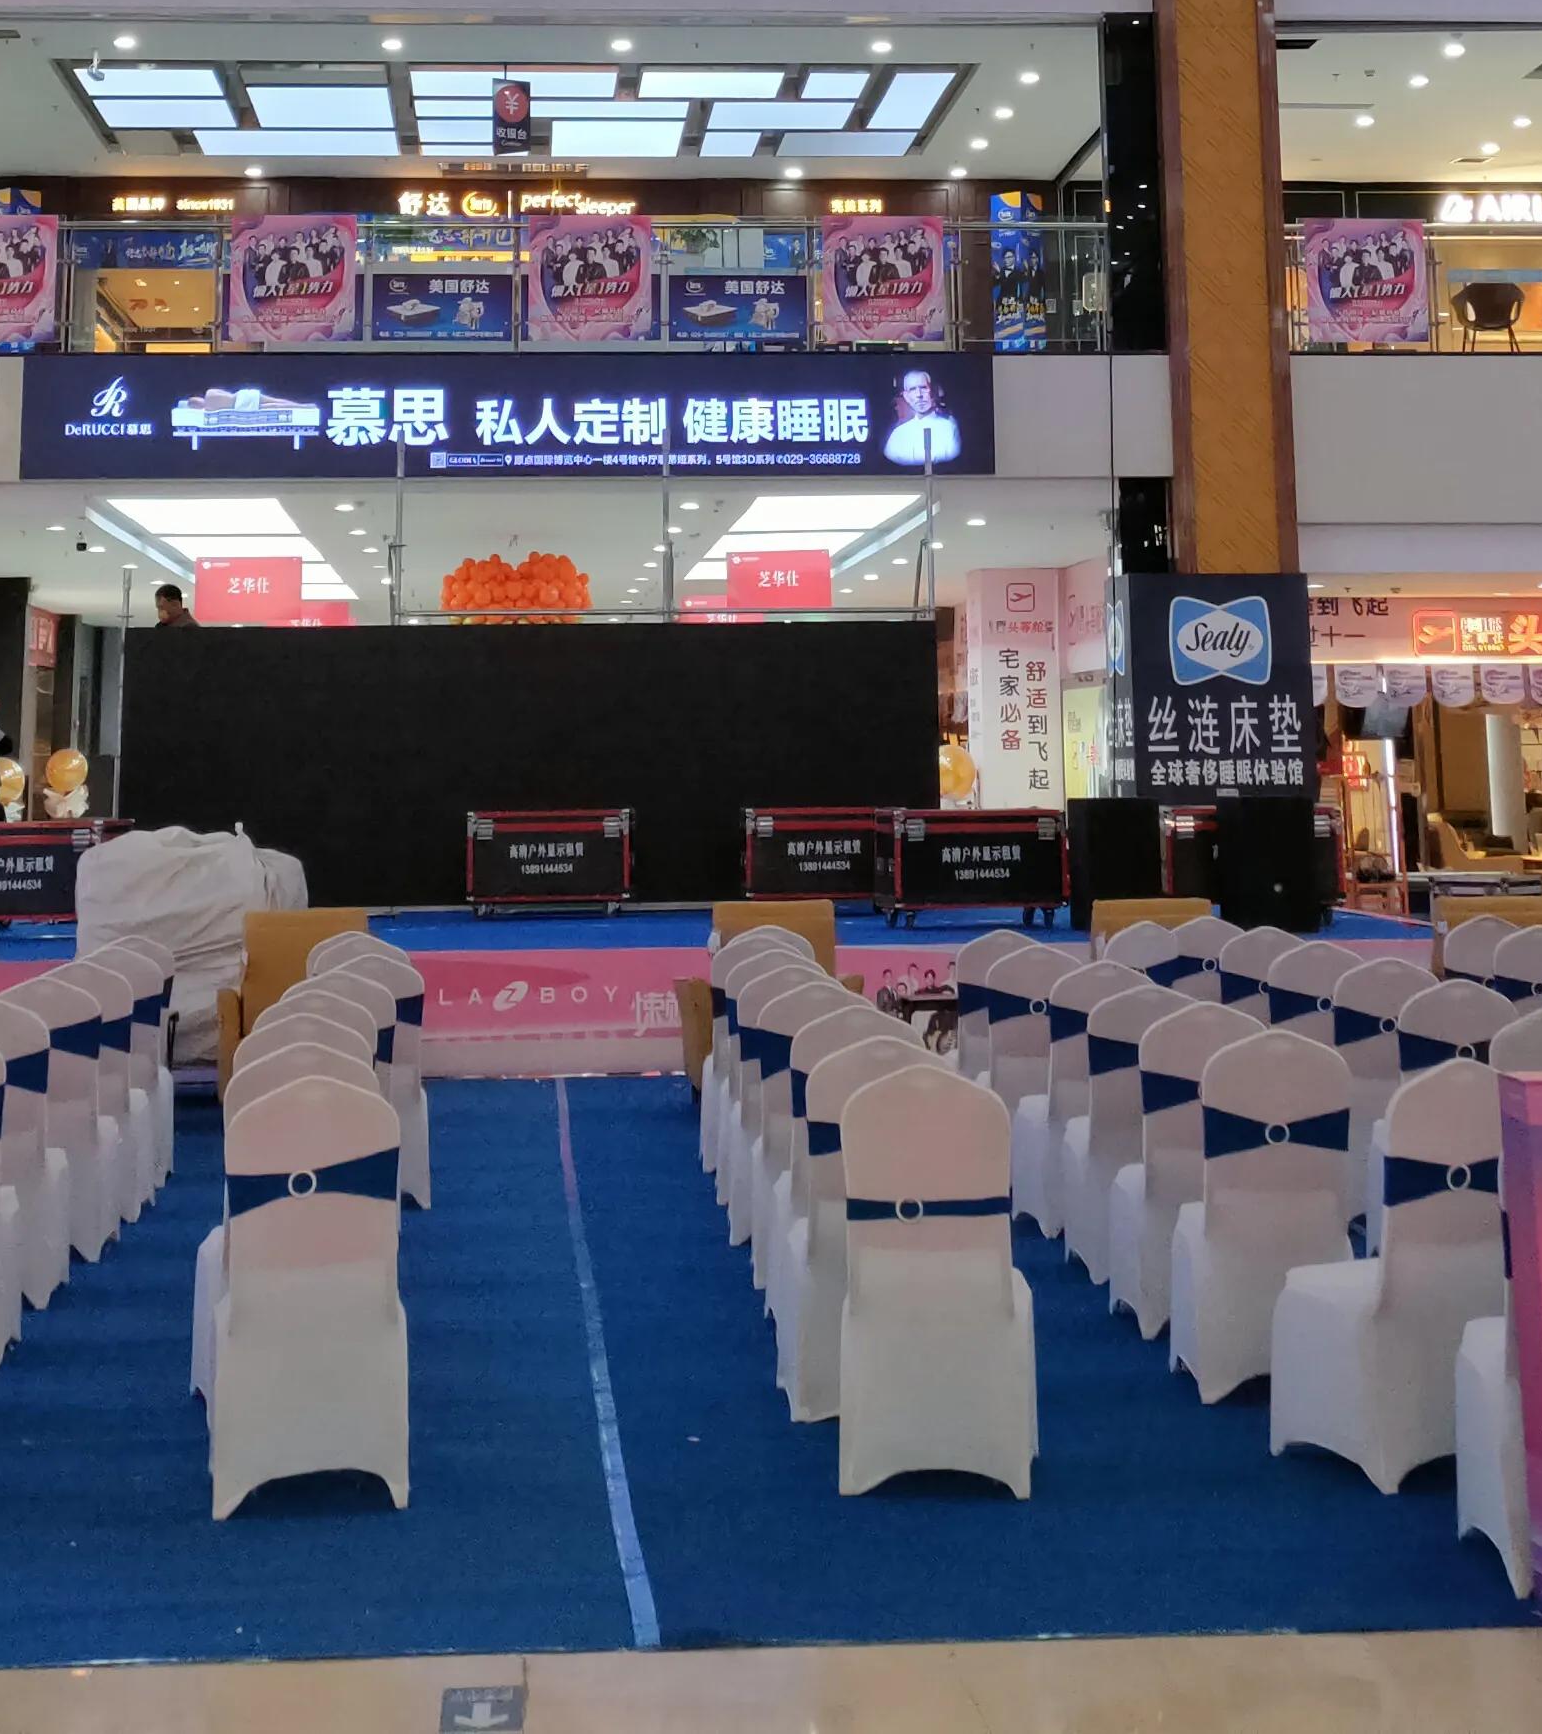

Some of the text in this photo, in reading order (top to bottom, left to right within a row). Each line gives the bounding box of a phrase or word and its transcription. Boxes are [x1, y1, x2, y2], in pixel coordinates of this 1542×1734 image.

[495, 127, 528, 141] 收银台
[397, 191, 451, 217] 舒达
[520, 192, 637, 217] perfect sleeper
[428, 279, 490, 295] 美国舒达
[724, 280, 786, 296] 美国舒达
[325, 386, 871, 445] 慕思 私人定制 健康睡眠
[783, 453, 861, 466] 029-36688728
[226, 576, 270, 595] 芝华仕
[758, 569, 799, 589] 芝华仕
[1184, 621, 1252, 658] Sealy
[998, 648, 1022, 752] 宅家必备
[1025, 660, 1050, 791] 舒适到飞起
[1147, 693, 1304, 756] 丝涟床垫
[1149, 758, 1305, 787] 全球奢侈睡眠体验馆
[509, 842, 585, 859] 高清户外显示租赁
[941, 845, 1021, 863] 高清户外显示租赁
